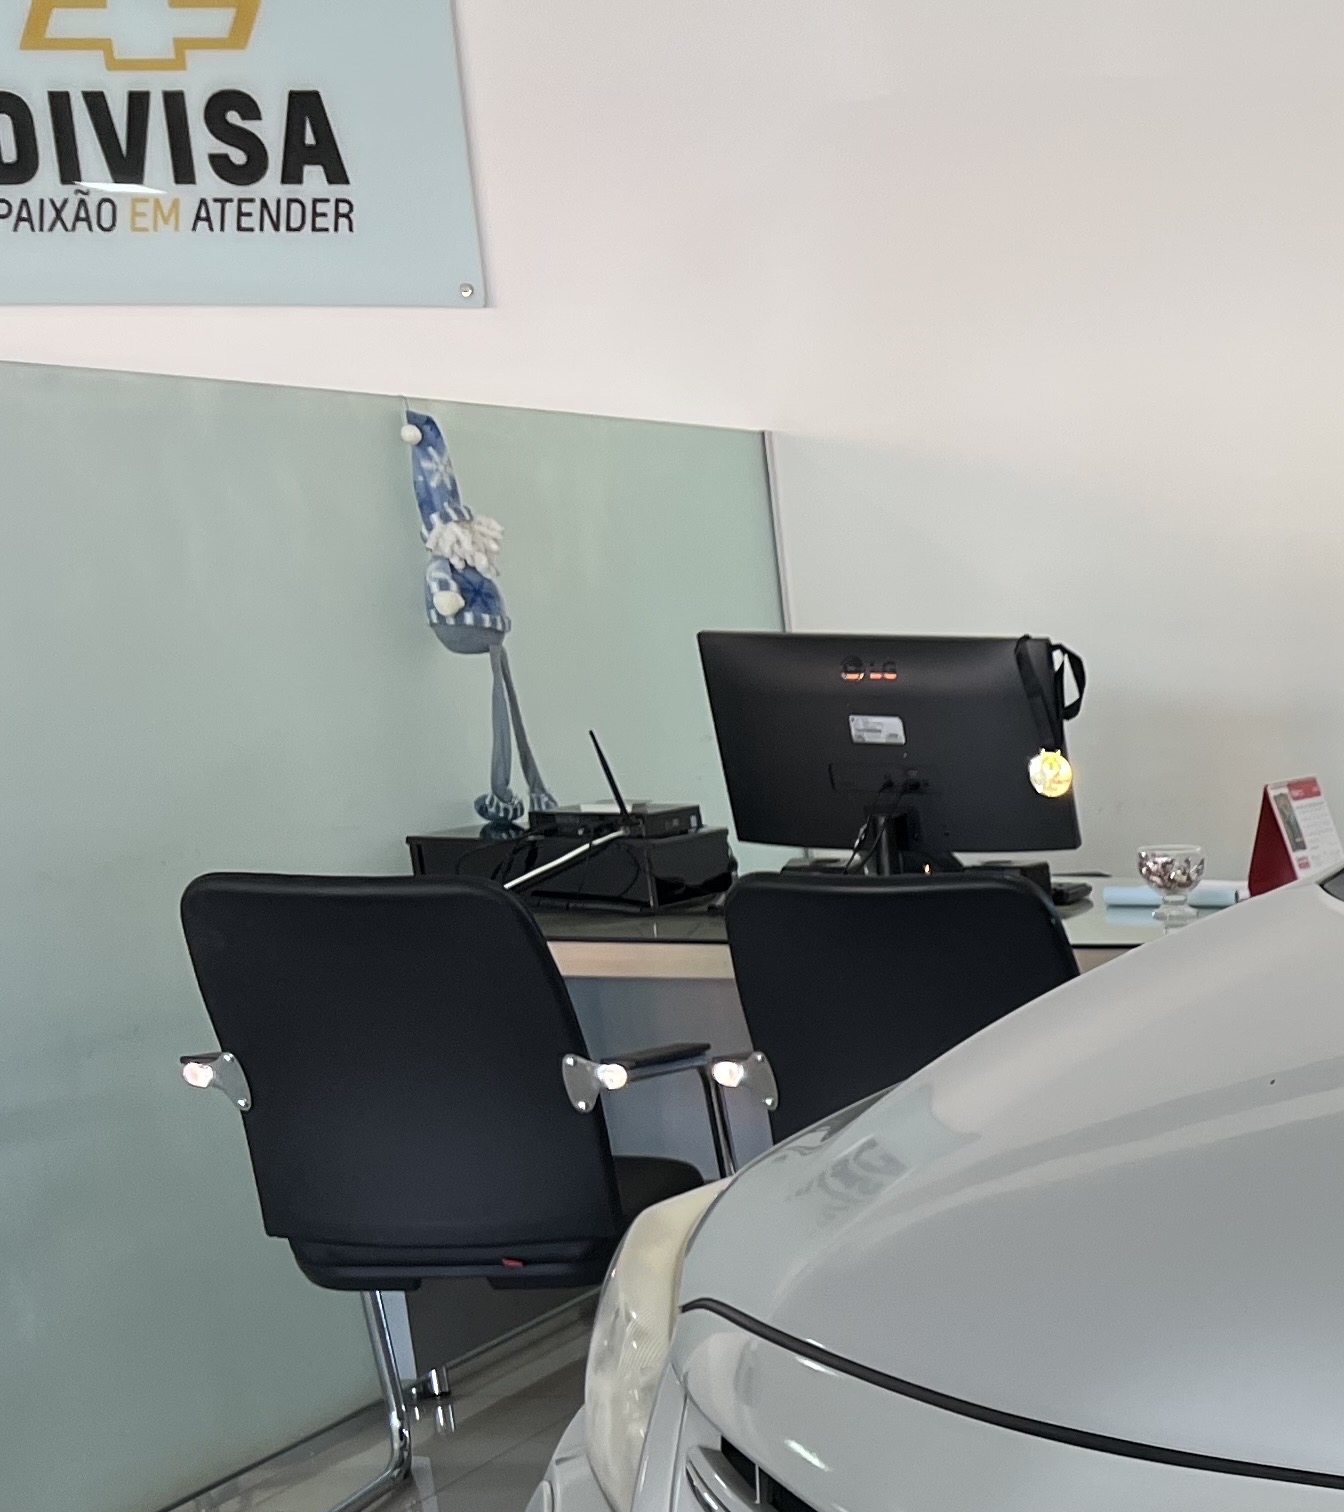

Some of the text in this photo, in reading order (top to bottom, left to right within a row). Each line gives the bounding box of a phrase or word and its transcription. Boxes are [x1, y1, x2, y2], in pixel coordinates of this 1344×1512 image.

[0, 88, 351, 187] DIVISA
[129, 198, 181, 233] EM
[191, 197, 355, 233] ATENDER
[868, 660, 898, 680] LG
